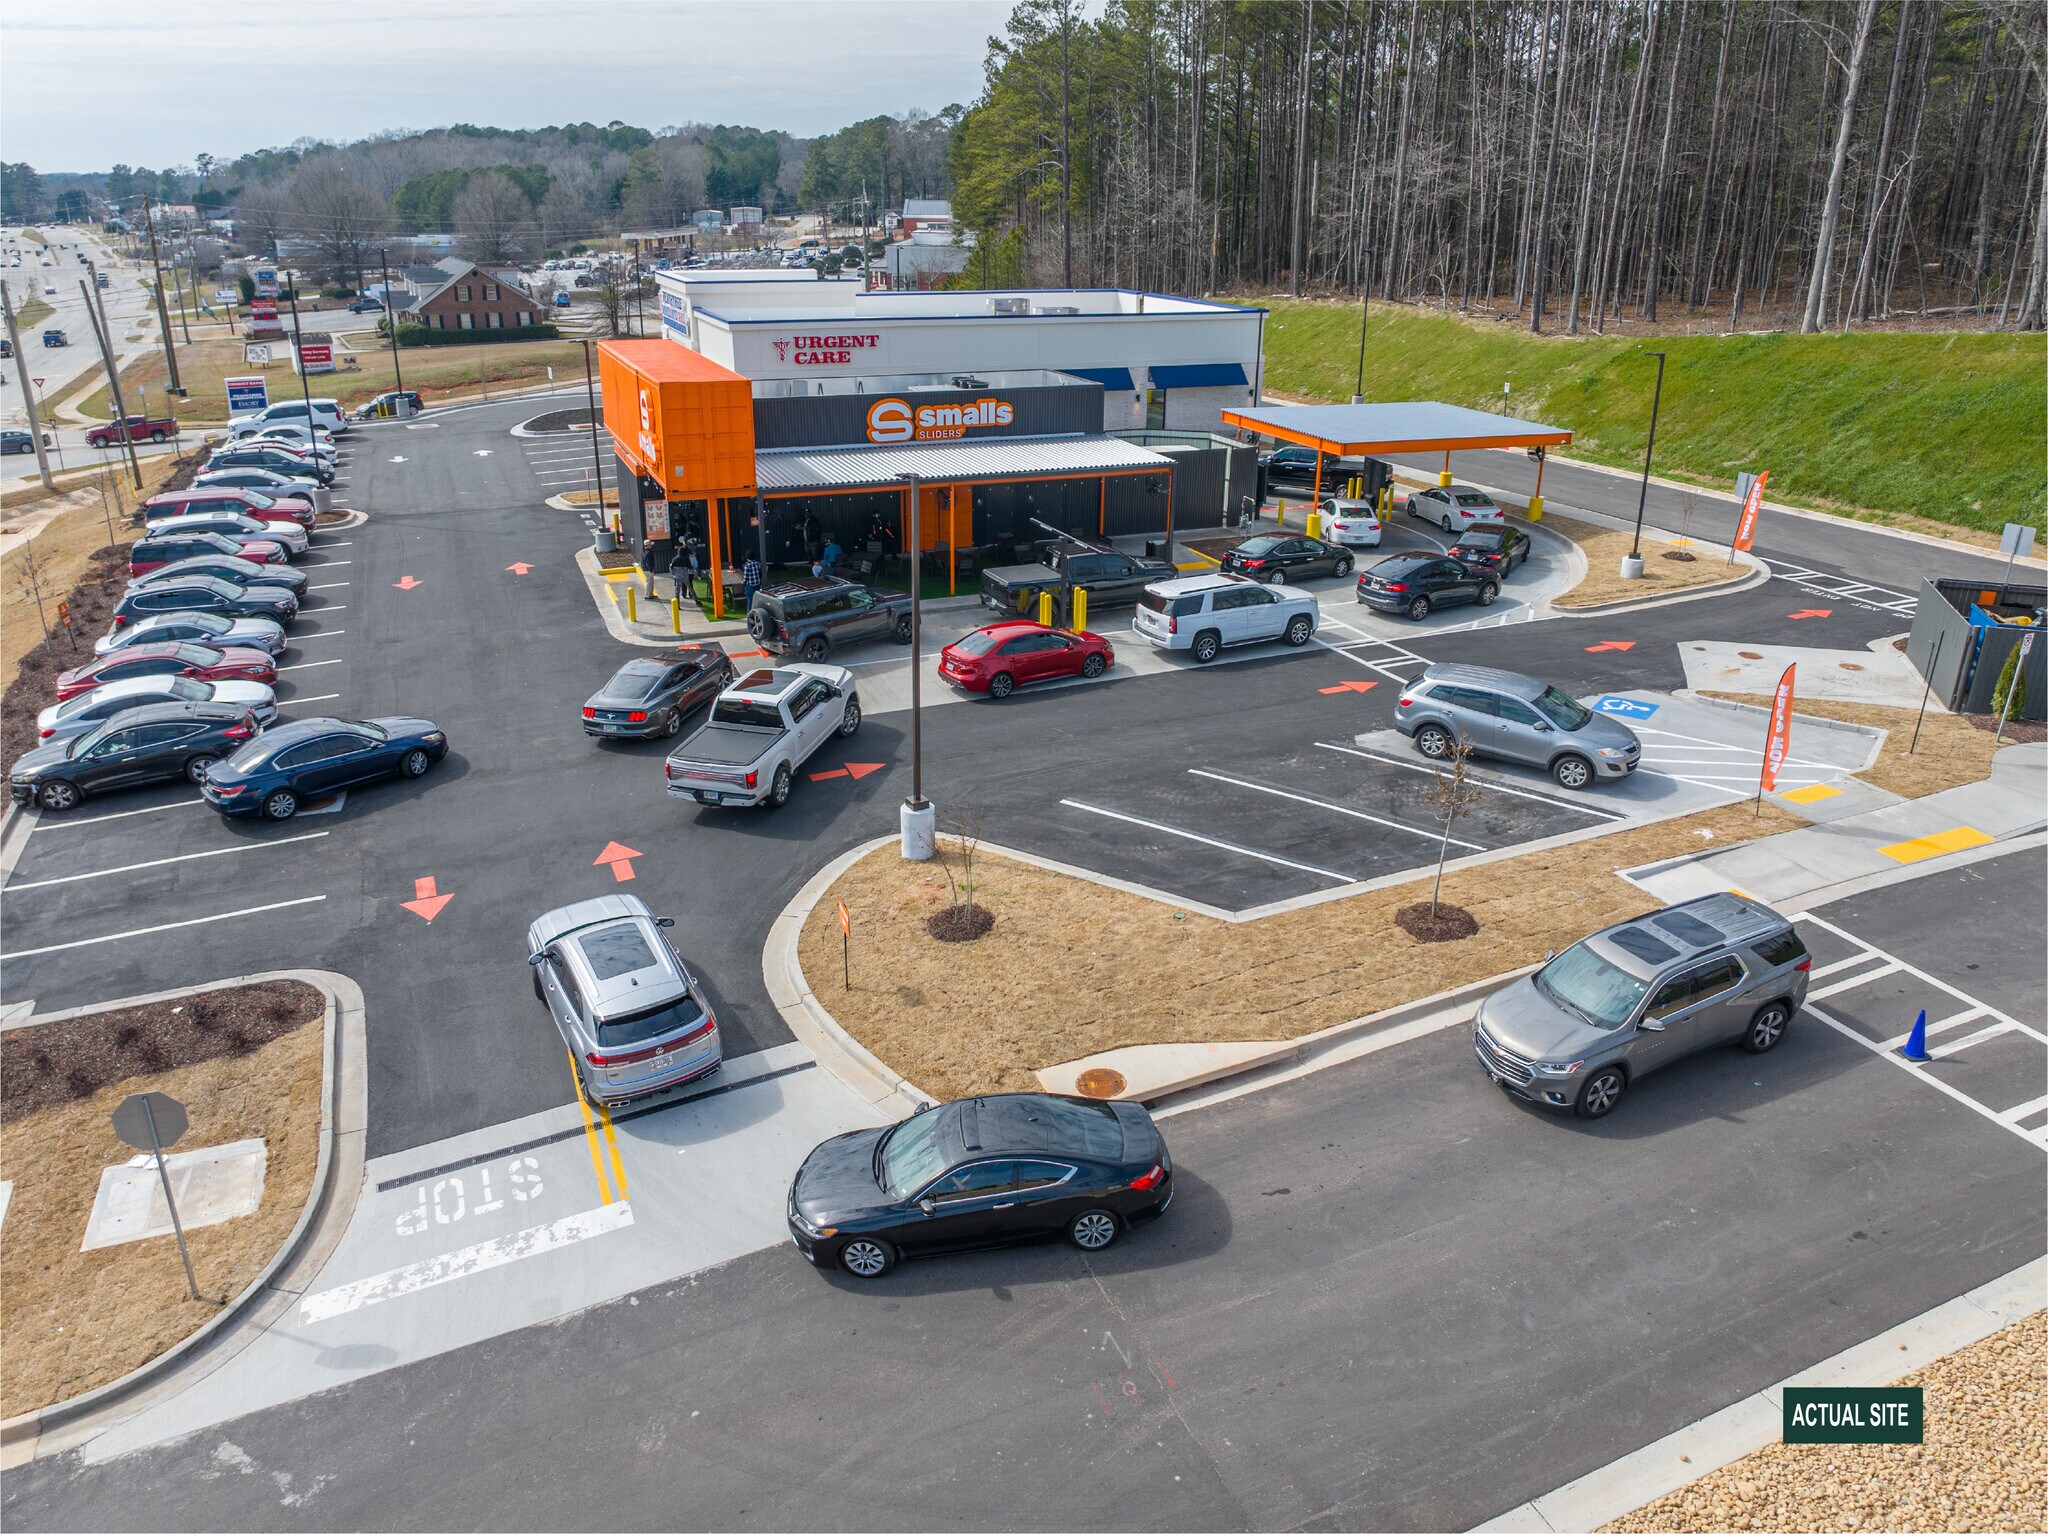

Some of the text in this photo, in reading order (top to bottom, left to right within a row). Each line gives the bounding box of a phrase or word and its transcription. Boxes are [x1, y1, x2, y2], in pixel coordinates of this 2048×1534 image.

[793, 335, 880, 349] URGENT
[794, 351, 851, 365] CARE
[919, 402, 1013, 427] smalls
[919, 430, 962, 439] SLIDERS
[1740, 482, 1762, 540] NOW OPEN
[1769, 735, 1784, 773] NOW
[396, 1157, 544, 1236] STOP
